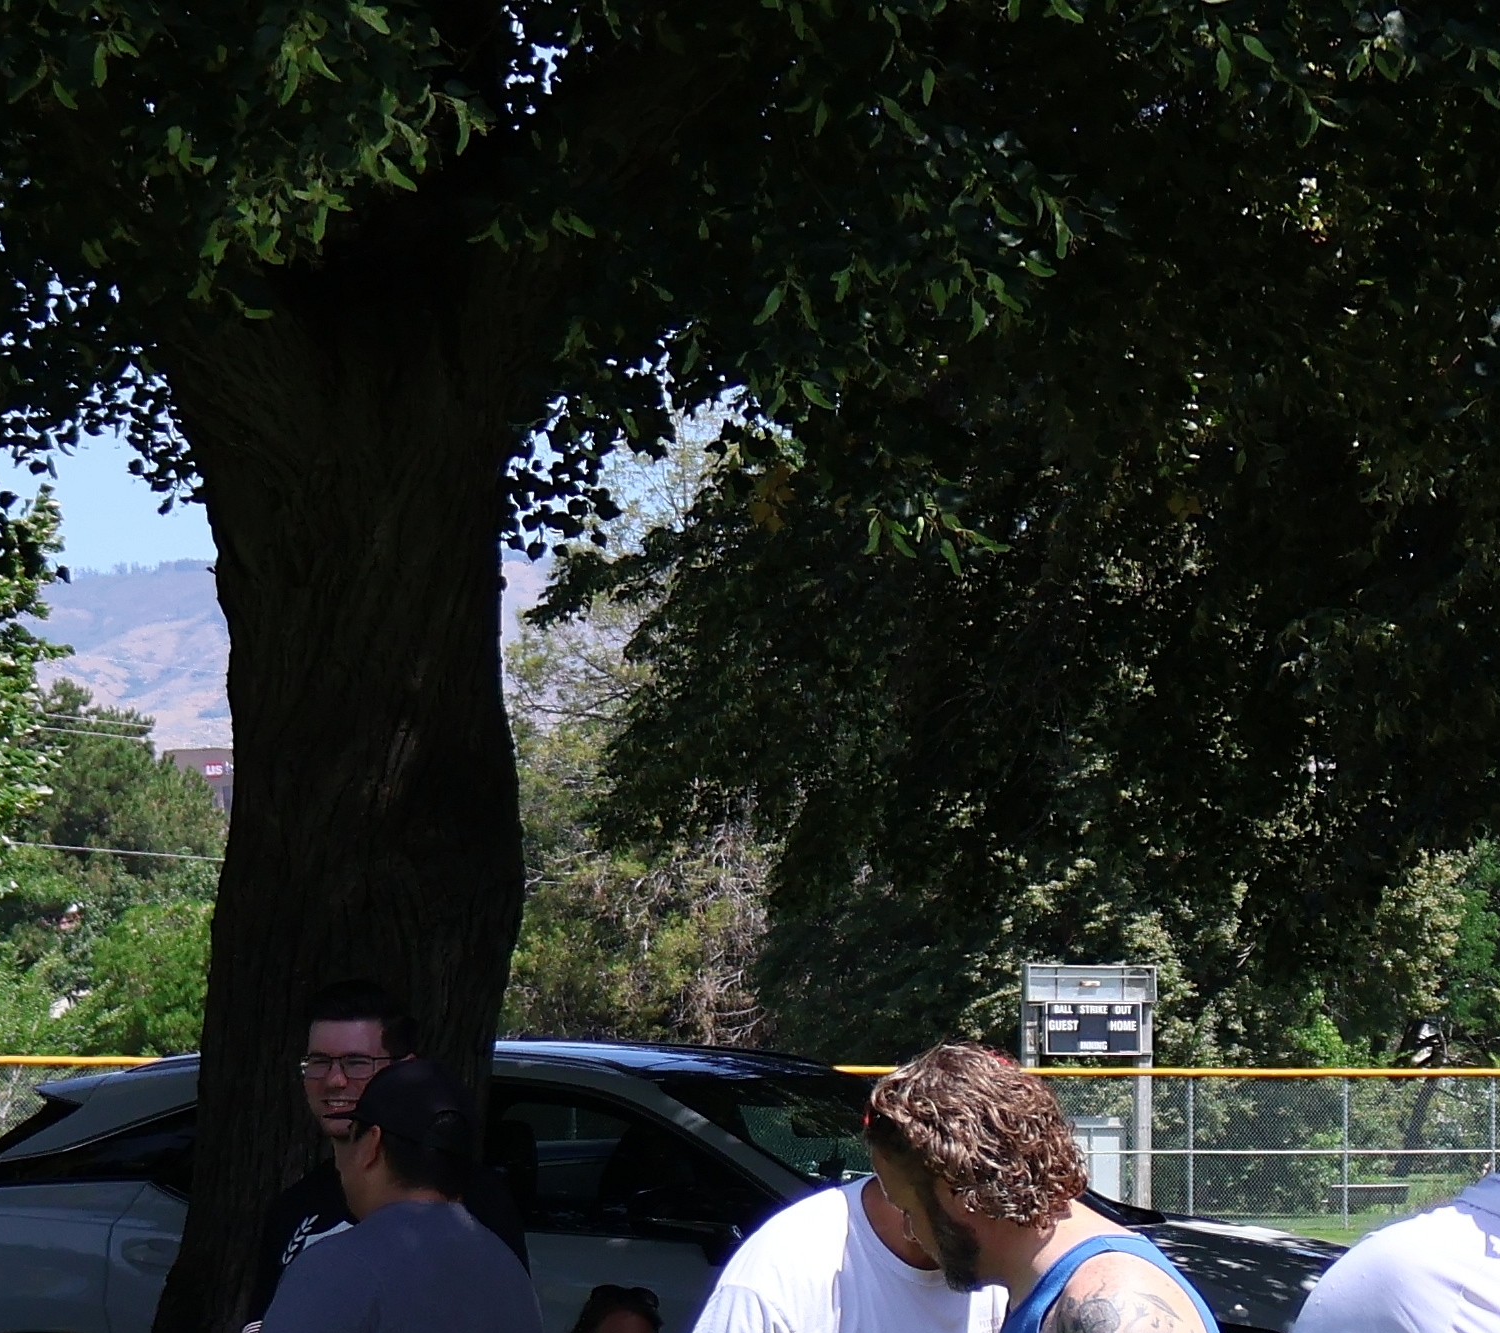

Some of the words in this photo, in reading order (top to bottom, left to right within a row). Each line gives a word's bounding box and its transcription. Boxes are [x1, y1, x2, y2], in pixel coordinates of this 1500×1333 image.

[1054, 1005, 1073, 1014] BALL
[1079, 1005, 1108, 1014] STRIKE
[1114, 1005, 1132, 1015] OUT
[1049, 1020, 1079, 1031] GUEST
[1110, 1020, 1137, 1031] HOME
